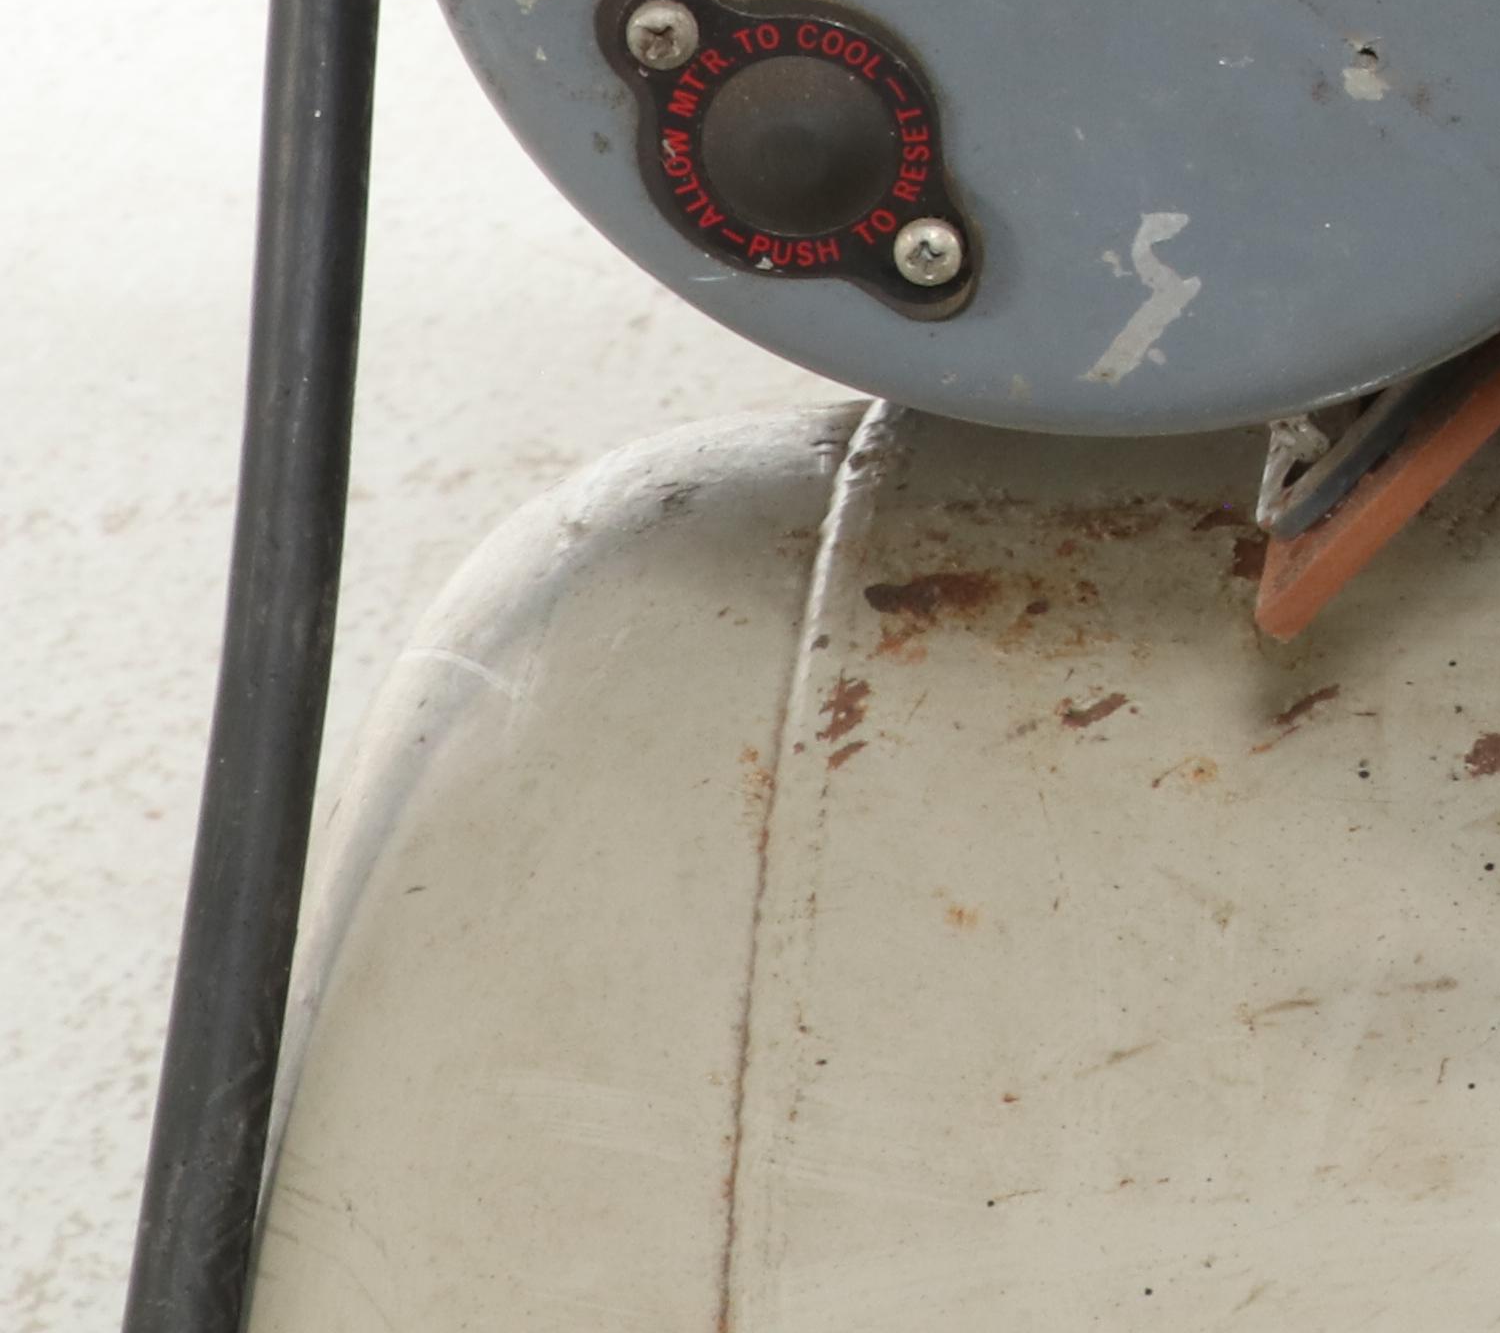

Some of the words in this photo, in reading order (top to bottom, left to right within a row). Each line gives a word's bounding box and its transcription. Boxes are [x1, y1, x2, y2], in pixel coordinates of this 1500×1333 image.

[660, 128, 726, 229] ALLOW
[733, 24, 782, 55] TO
[796, 23, 888, 81] COOL
[747, 234, 842, 267] PUSH
[851, 209, 897, 246] TO
[892, 108, 931, 202] RESET
